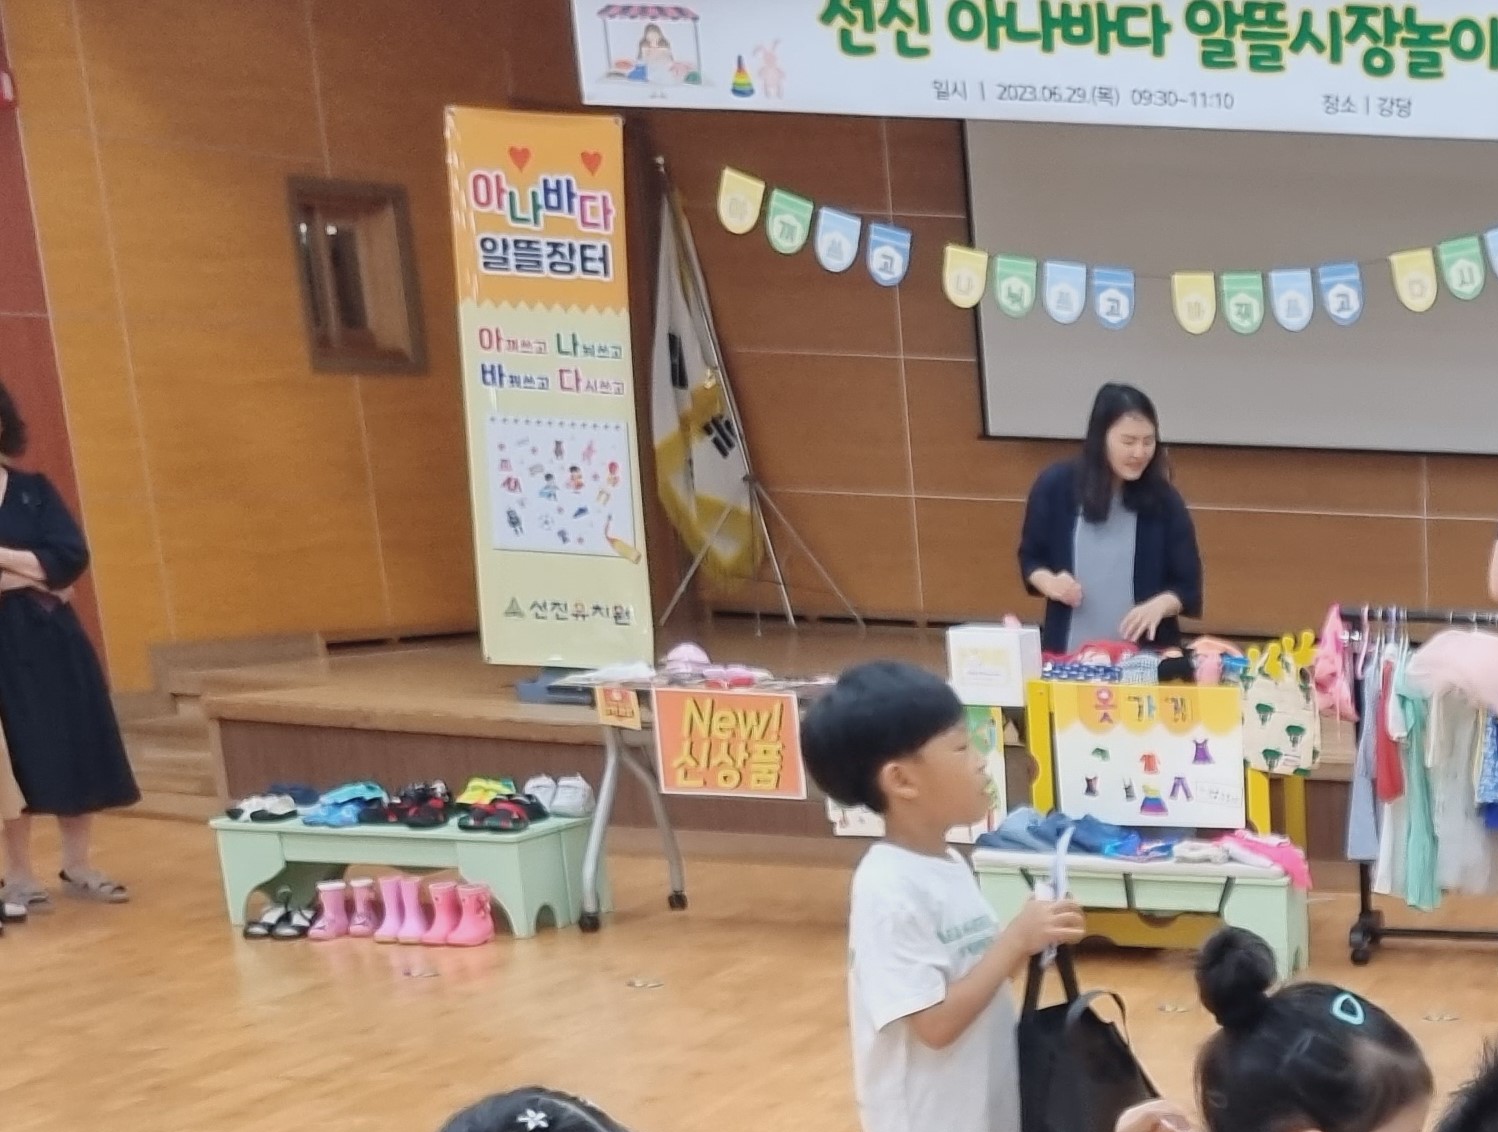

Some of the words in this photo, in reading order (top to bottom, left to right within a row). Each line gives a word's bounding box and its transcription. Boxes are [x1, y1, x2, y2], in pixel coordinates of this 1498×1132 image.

[947, 0, 1172, 57] 아나바다
[931, 79, 968, 101] 일시
[1322, 93, 1358, 116] 장소
[1377, 96, 1412, 118] 강당
[471, 173, 615, 231] 아나바다
[479, 235, 613, 278] 알뜰장터
[530, 600, 631, 626] 선진유치원
[682, 696, 784, 741] New!
[672, 739, 785, 790] 신상품
